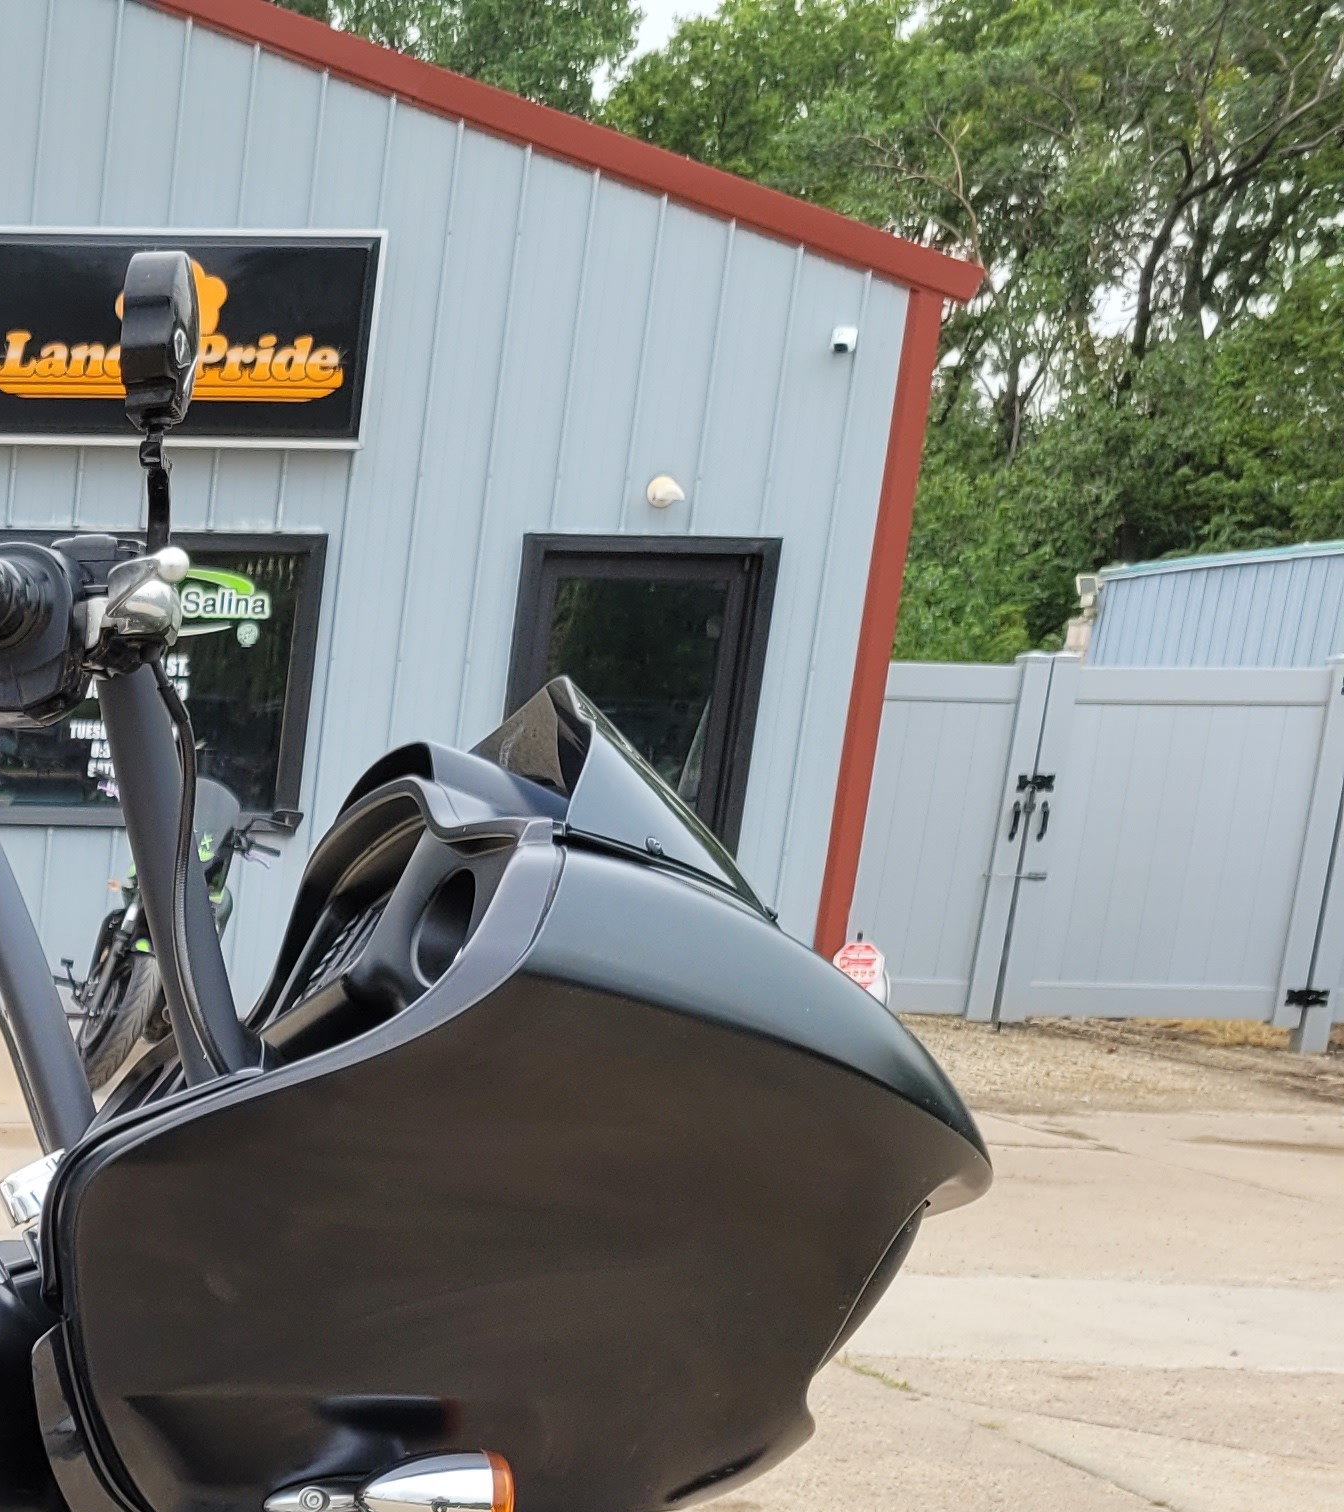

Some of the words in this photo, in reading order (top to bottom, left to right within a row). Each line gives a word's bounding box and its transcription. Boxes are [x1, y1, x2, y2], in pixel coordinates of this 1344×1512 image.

[195, 332, 341, 382] Pride
[182, 590, 267, 616] Salina
[69, 719, 108, 740] TUES
